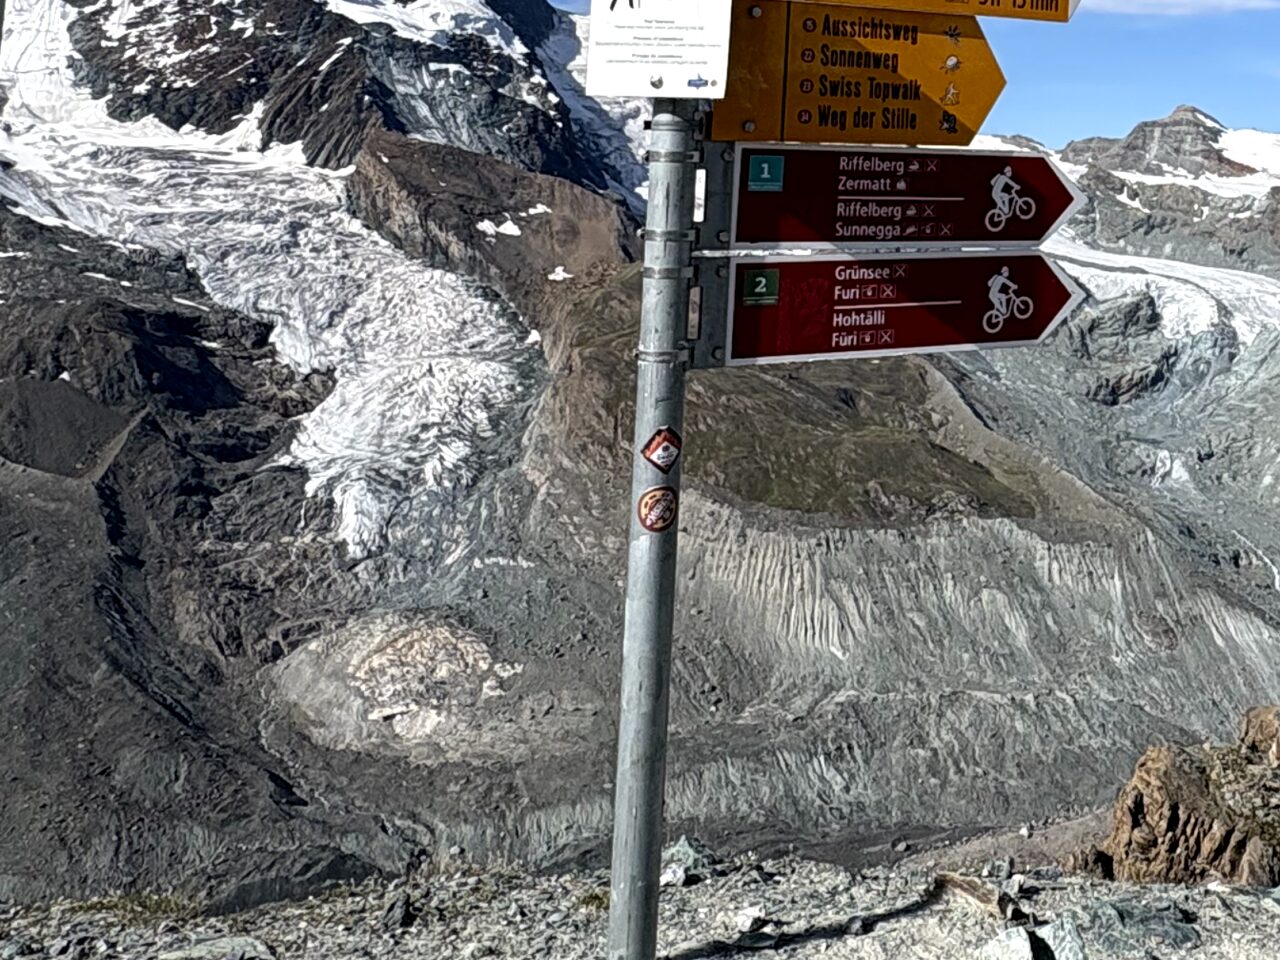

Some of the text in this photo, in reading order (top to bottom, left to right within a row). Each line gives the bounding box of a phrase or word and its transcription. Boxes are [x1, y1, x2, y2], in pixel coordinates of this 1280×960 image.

[822, 13, 919, 45] Aussichtsweg
[820, 43, 899, 74] Sonnenweg
[819, 74, 862, 98] Swiss
[867, 76, 921, 103] Topwalk
[817, 104, 848, 131] Weg
[853, 106, 876, 129] der
[882, 106, 917, 130] Stille
[760, 156, 905, 178] 1 Riffelberg
[838, 176, 891, 191] Zermatt
[836, 202, 903, 221] Riffelberg
[835, 221, 901, 239] Sunnegga
[754, 264, 891, 293] 2 Grünsee
[834, 284, 860, 300] Furi
[832, 310, 886, 327] Hohtälli
[831, 331, 859, 348] Füri
